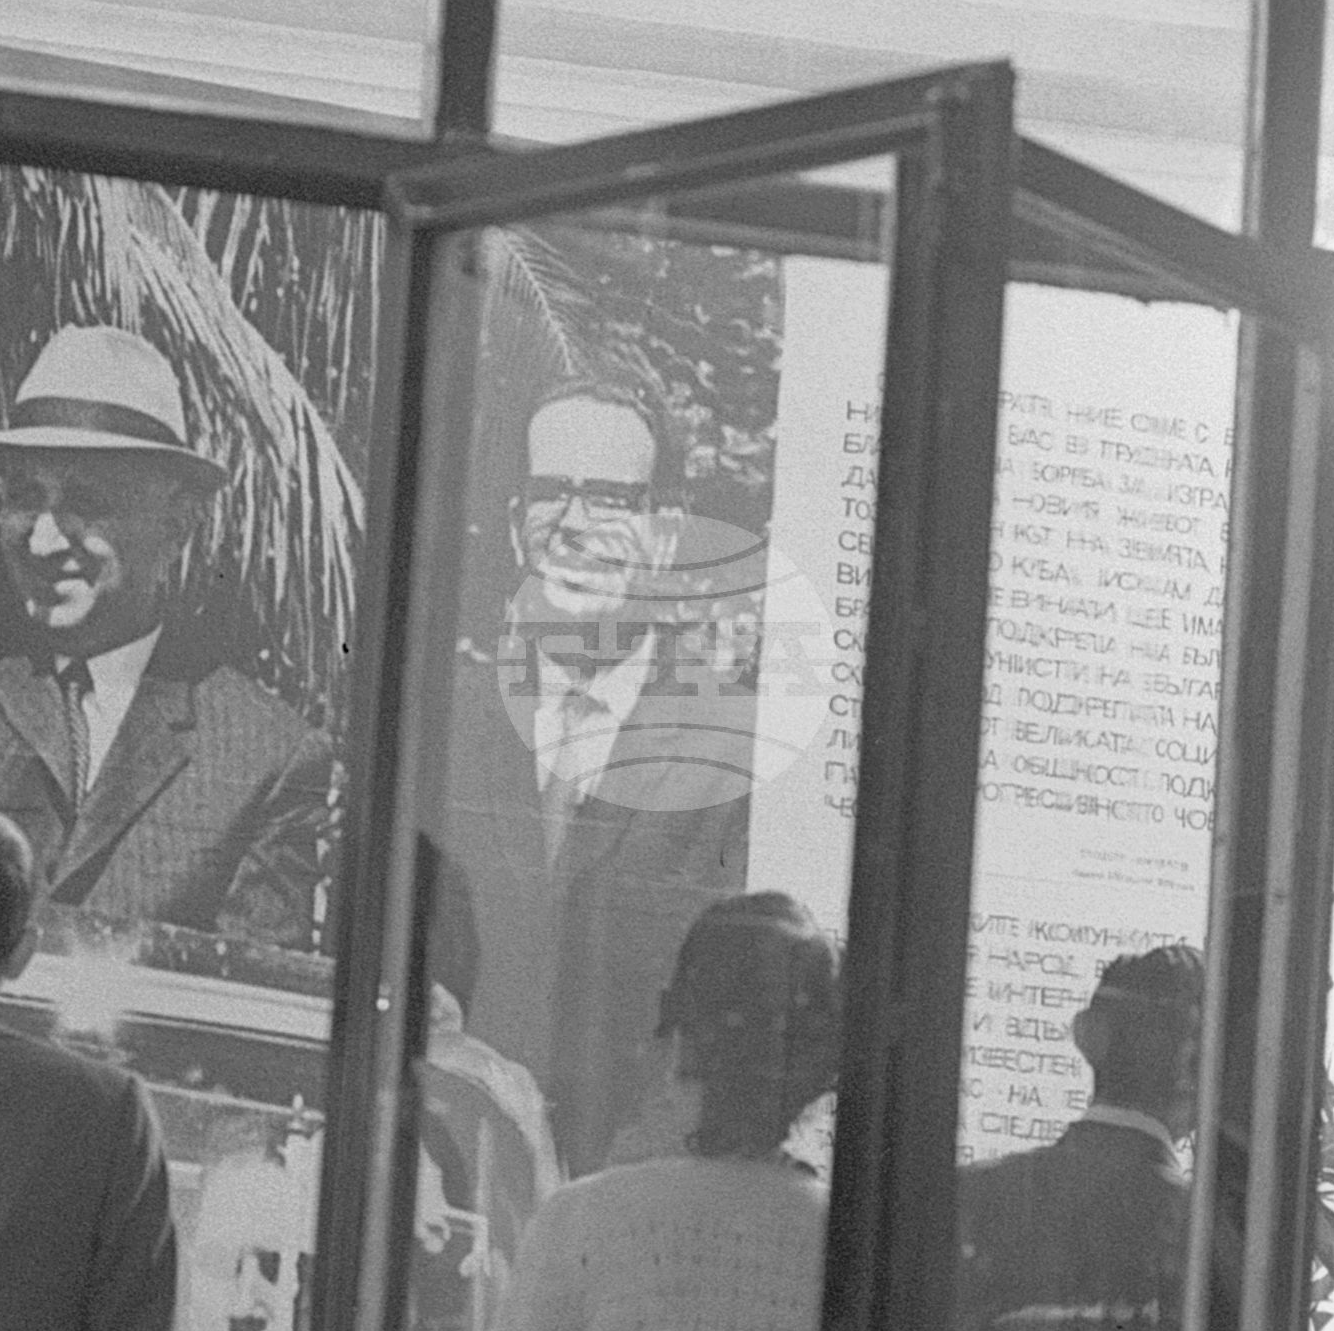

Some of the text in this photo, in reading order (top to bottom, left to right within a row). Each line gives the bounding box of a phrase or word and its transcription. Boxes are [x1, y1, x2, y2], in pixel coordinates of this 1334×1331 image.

[1166, 484, 1230, 513] ИЗГРА
[1182, 613, 1224, 637] ИМА
[1142, 672, 1221, 702] БЪЛГАР
[1156, 738, 1218, 765] СОЦИ
